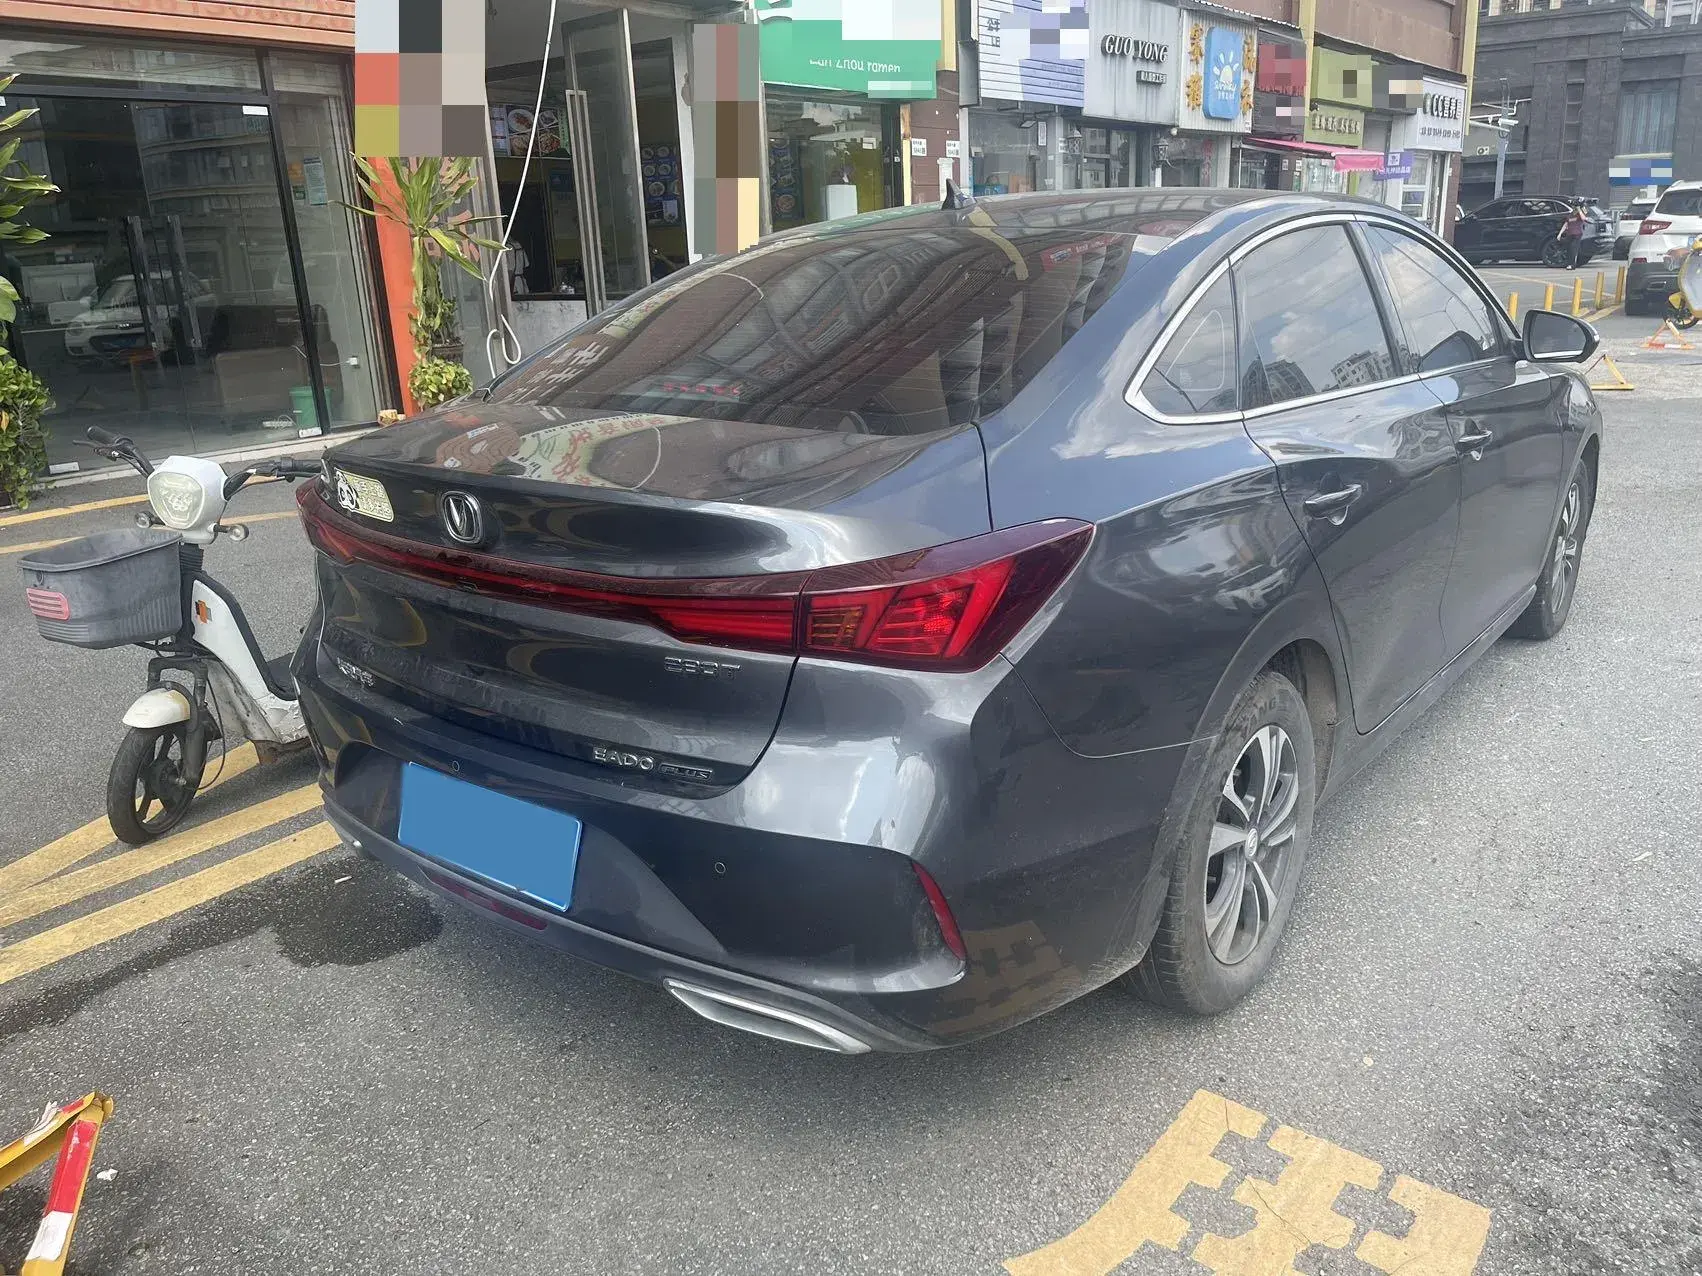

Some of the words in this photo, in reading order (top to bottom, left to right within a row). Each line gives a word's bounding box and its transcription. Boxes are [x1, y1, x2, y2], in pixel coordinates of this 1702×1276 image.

[1105, 34, 1133, 56] GUO
[1136, 39, 1168, 62] YONG
[593, 746, 654, 771] EADO
[661, 764, 710, 780] PLUS
